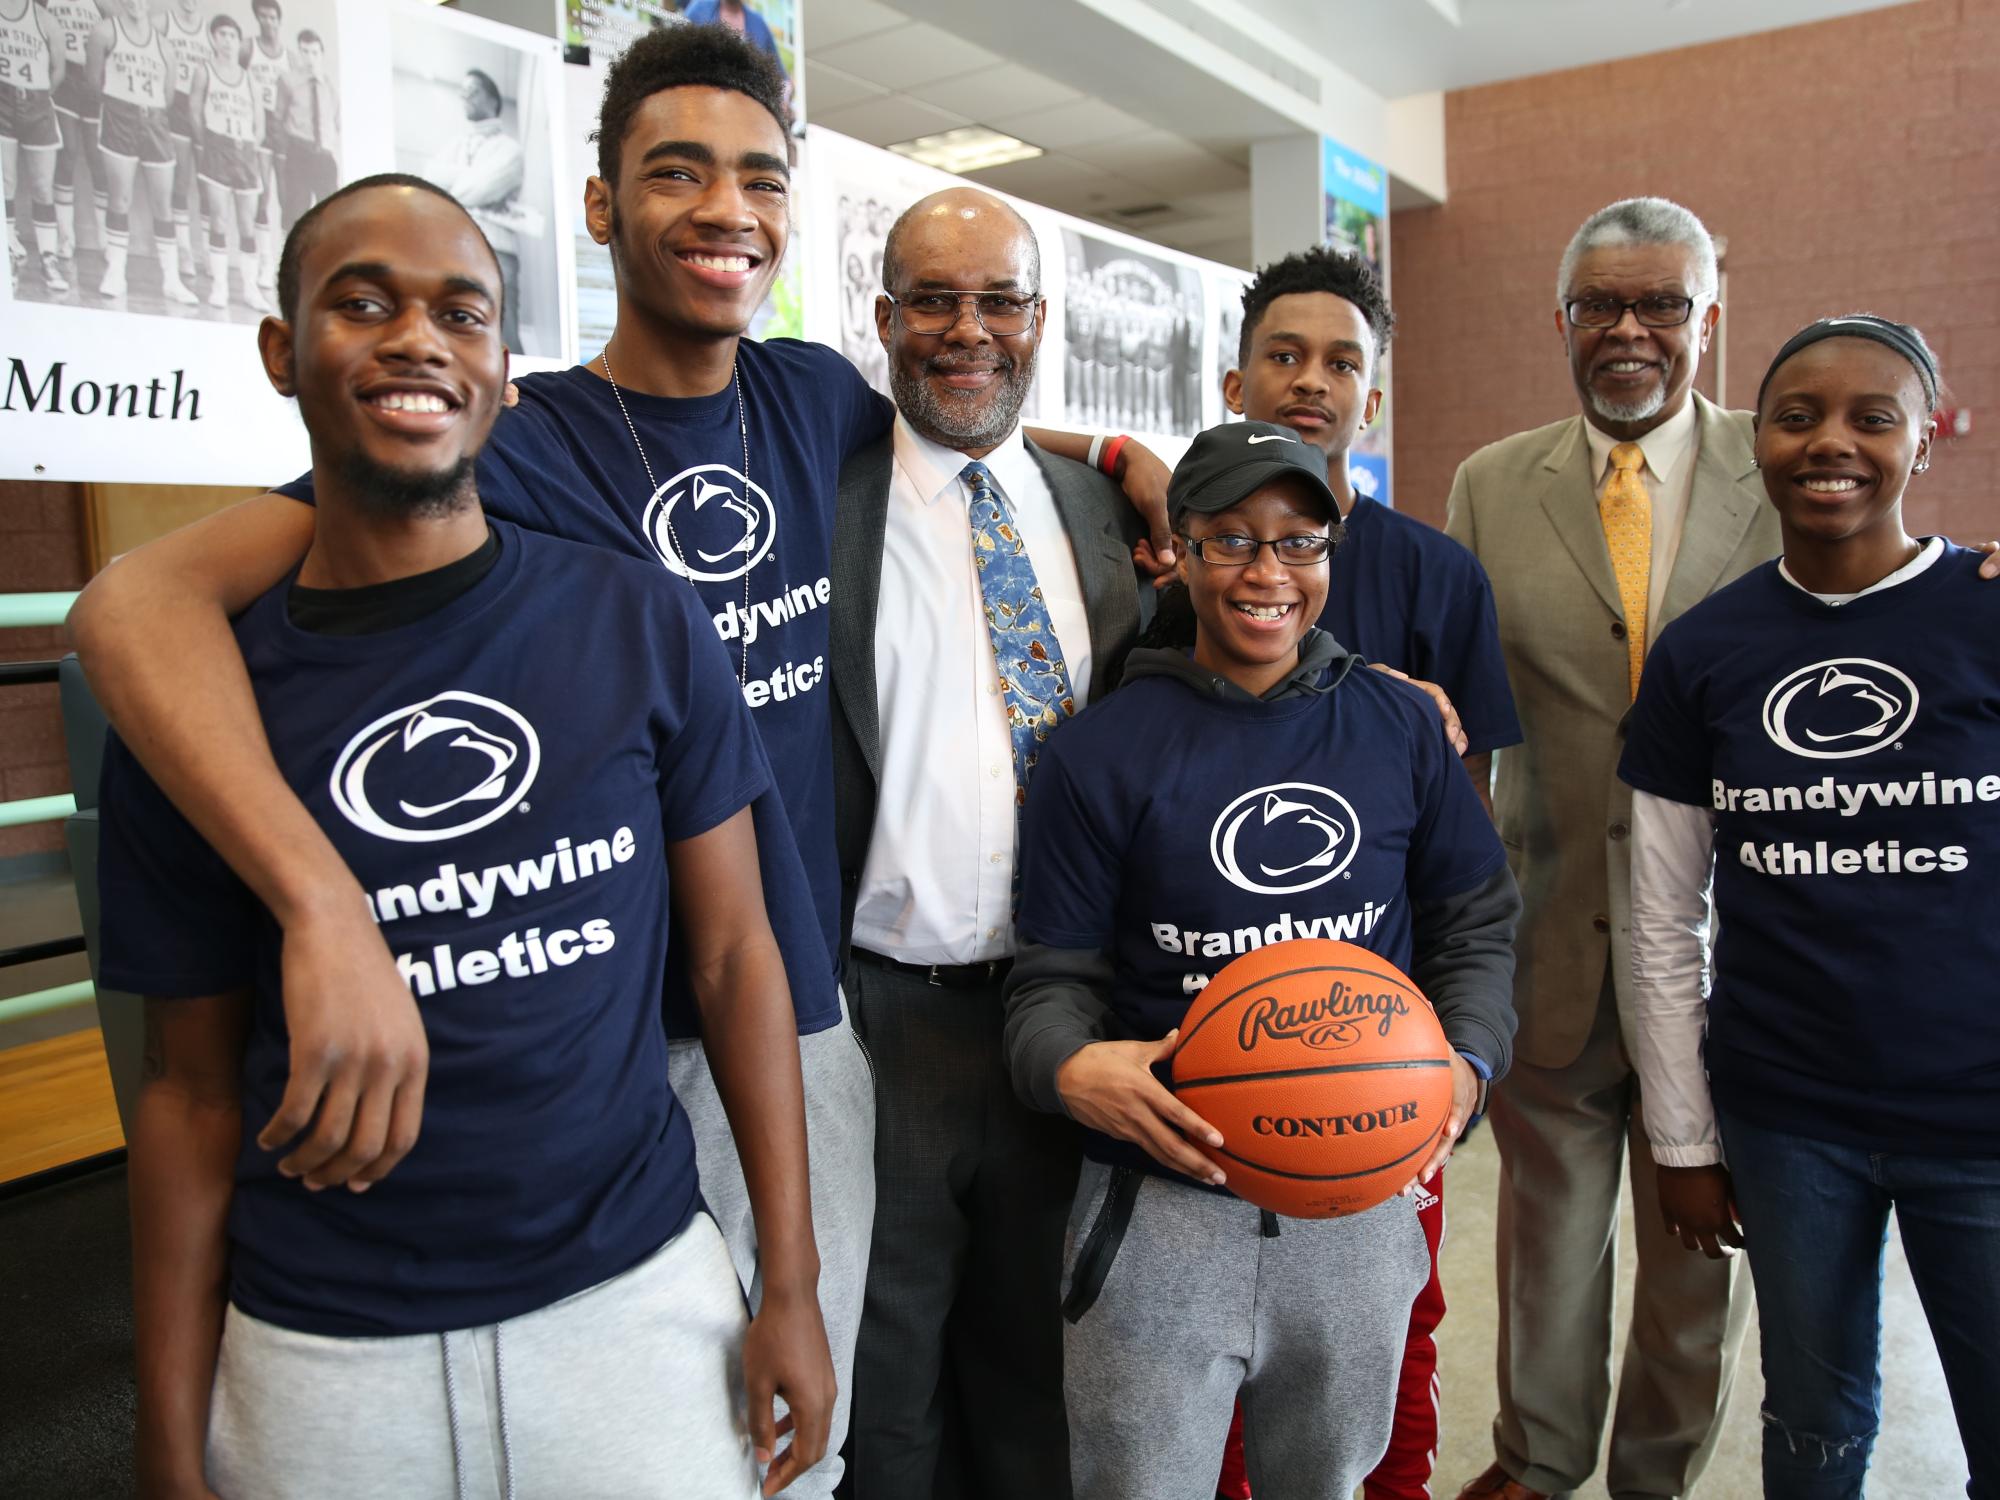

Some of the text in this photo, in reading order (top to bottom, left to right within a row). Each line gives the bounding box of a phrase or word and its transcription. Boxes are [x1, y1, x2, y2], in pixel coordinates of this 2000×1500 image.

[0, 57, 33, 83] 24
[0, 357, 202, 421] Month
[712, 576, 831, 645] dywine
[743, 655, 824, 708] etics
[1712, 771, 2000, 817] Brandywine
[374, 826, 636, 922] ndywine
[1739, 840, 1969, 876] Athletics
[396, 918, 616, 997] hletics
[1238, 981, 1410, 1051] Rawlings
[1252, 1100, 1419, 1138] CONTOUR
[1416, 1195, 1439, 1211] das
